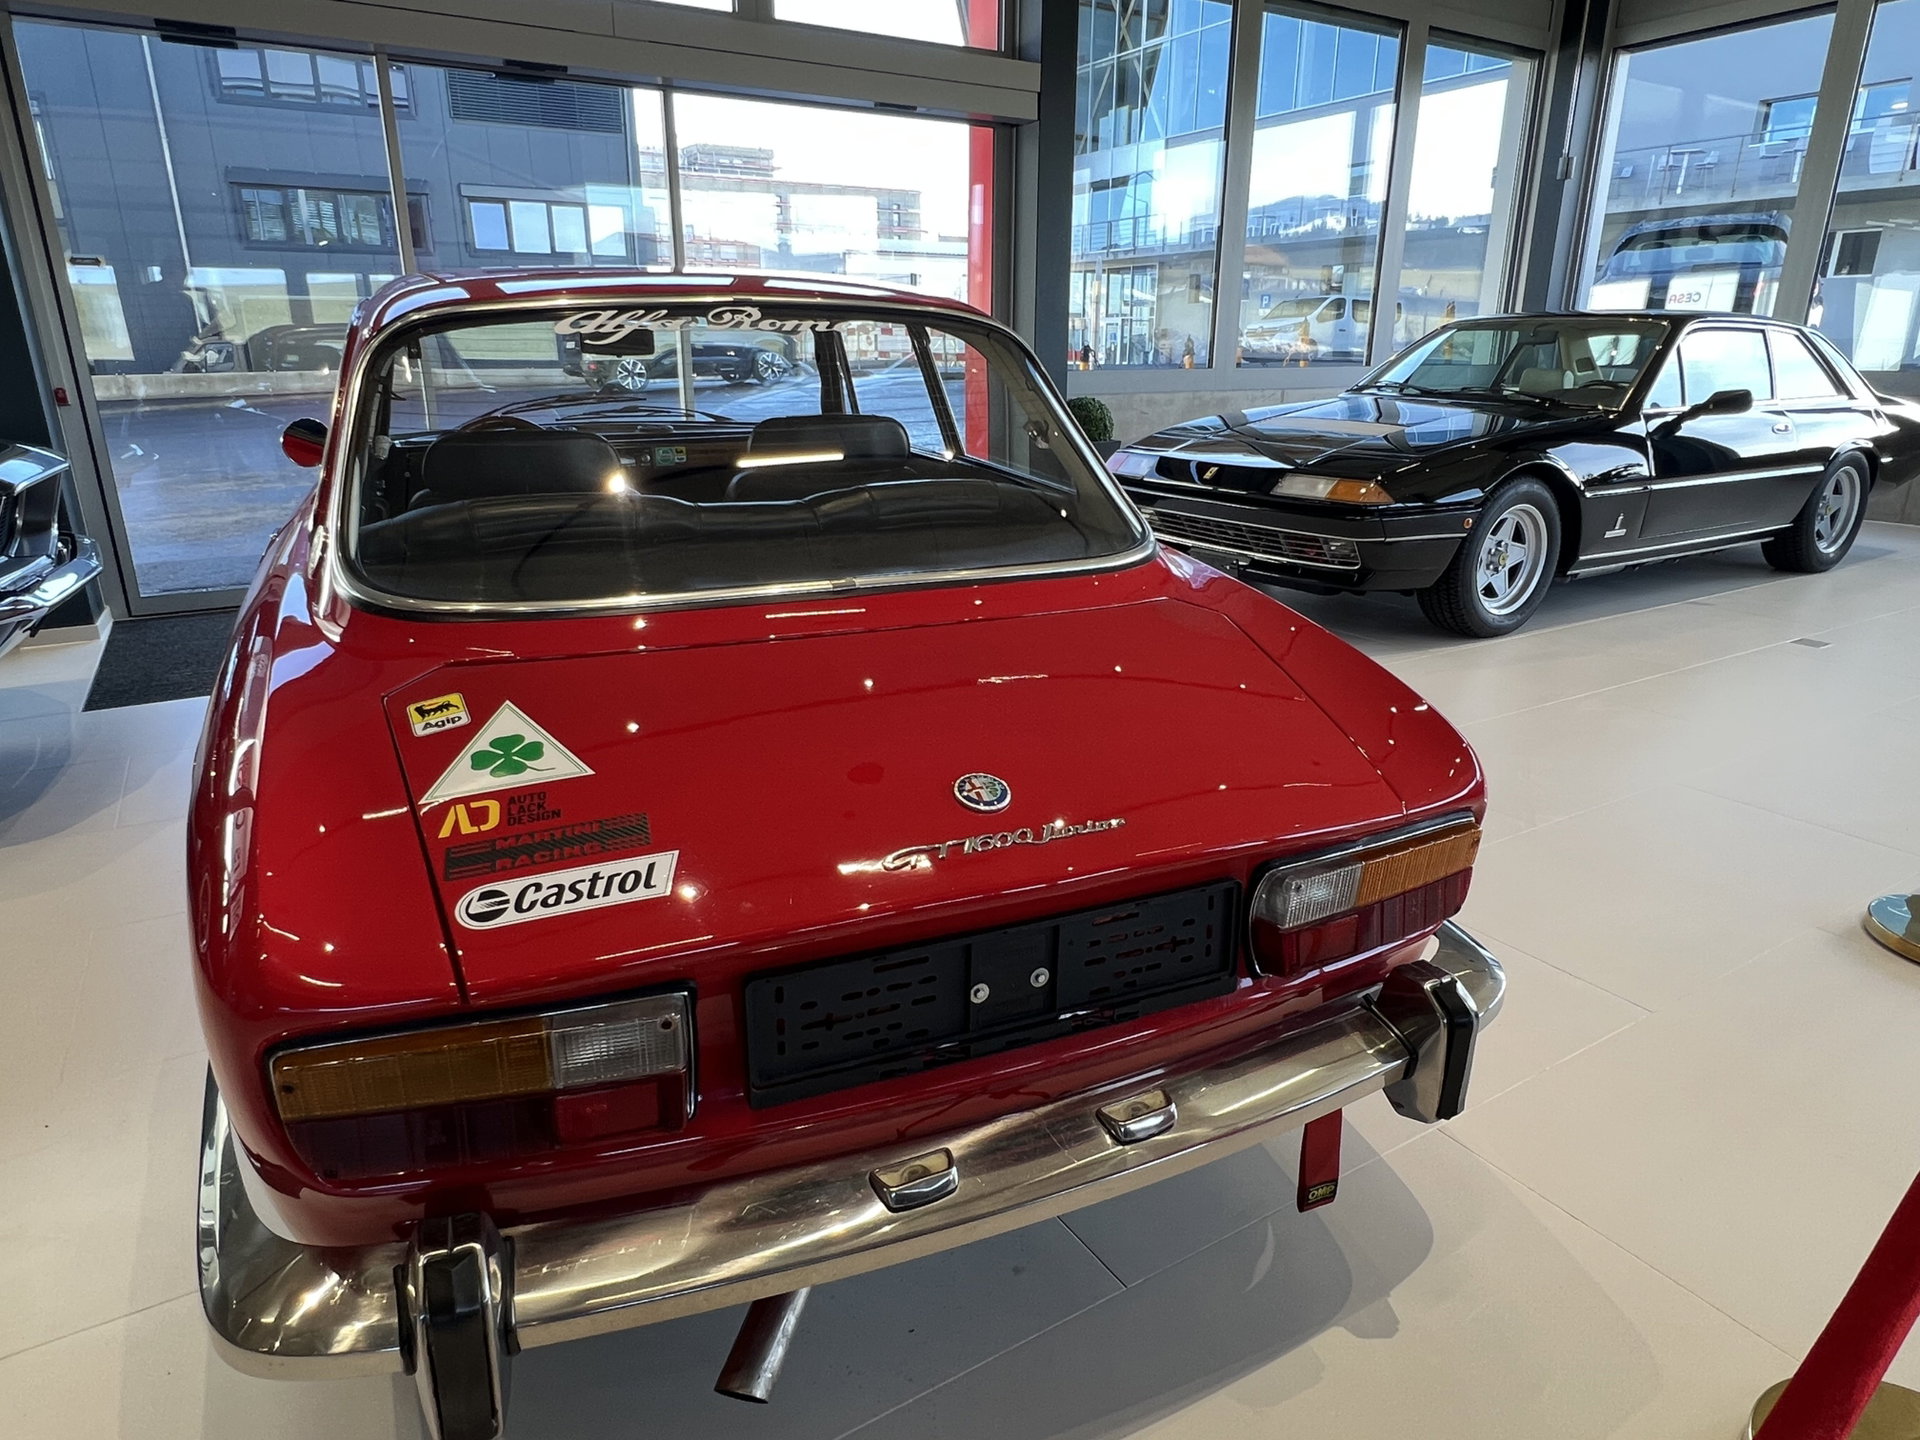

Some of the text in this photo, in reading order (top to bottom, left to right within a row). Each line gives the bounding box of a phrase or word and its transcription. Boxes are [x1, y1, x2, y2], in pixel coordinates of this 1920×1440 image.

[554, 309, 690, 346] Alfa
[421, 715, 463, 731] Agip
[507, 791, 547, 806] AUTO
[507, 801, 547, 817] LACK
[507, 809, 562, 827] DESIGN
[963, 827, 1034, 855] 1600
[495, 842, 603, 872] RACING
[513, 861, 657, 915] Castrol
[1308, 1185, 1335, 1200] OMP
